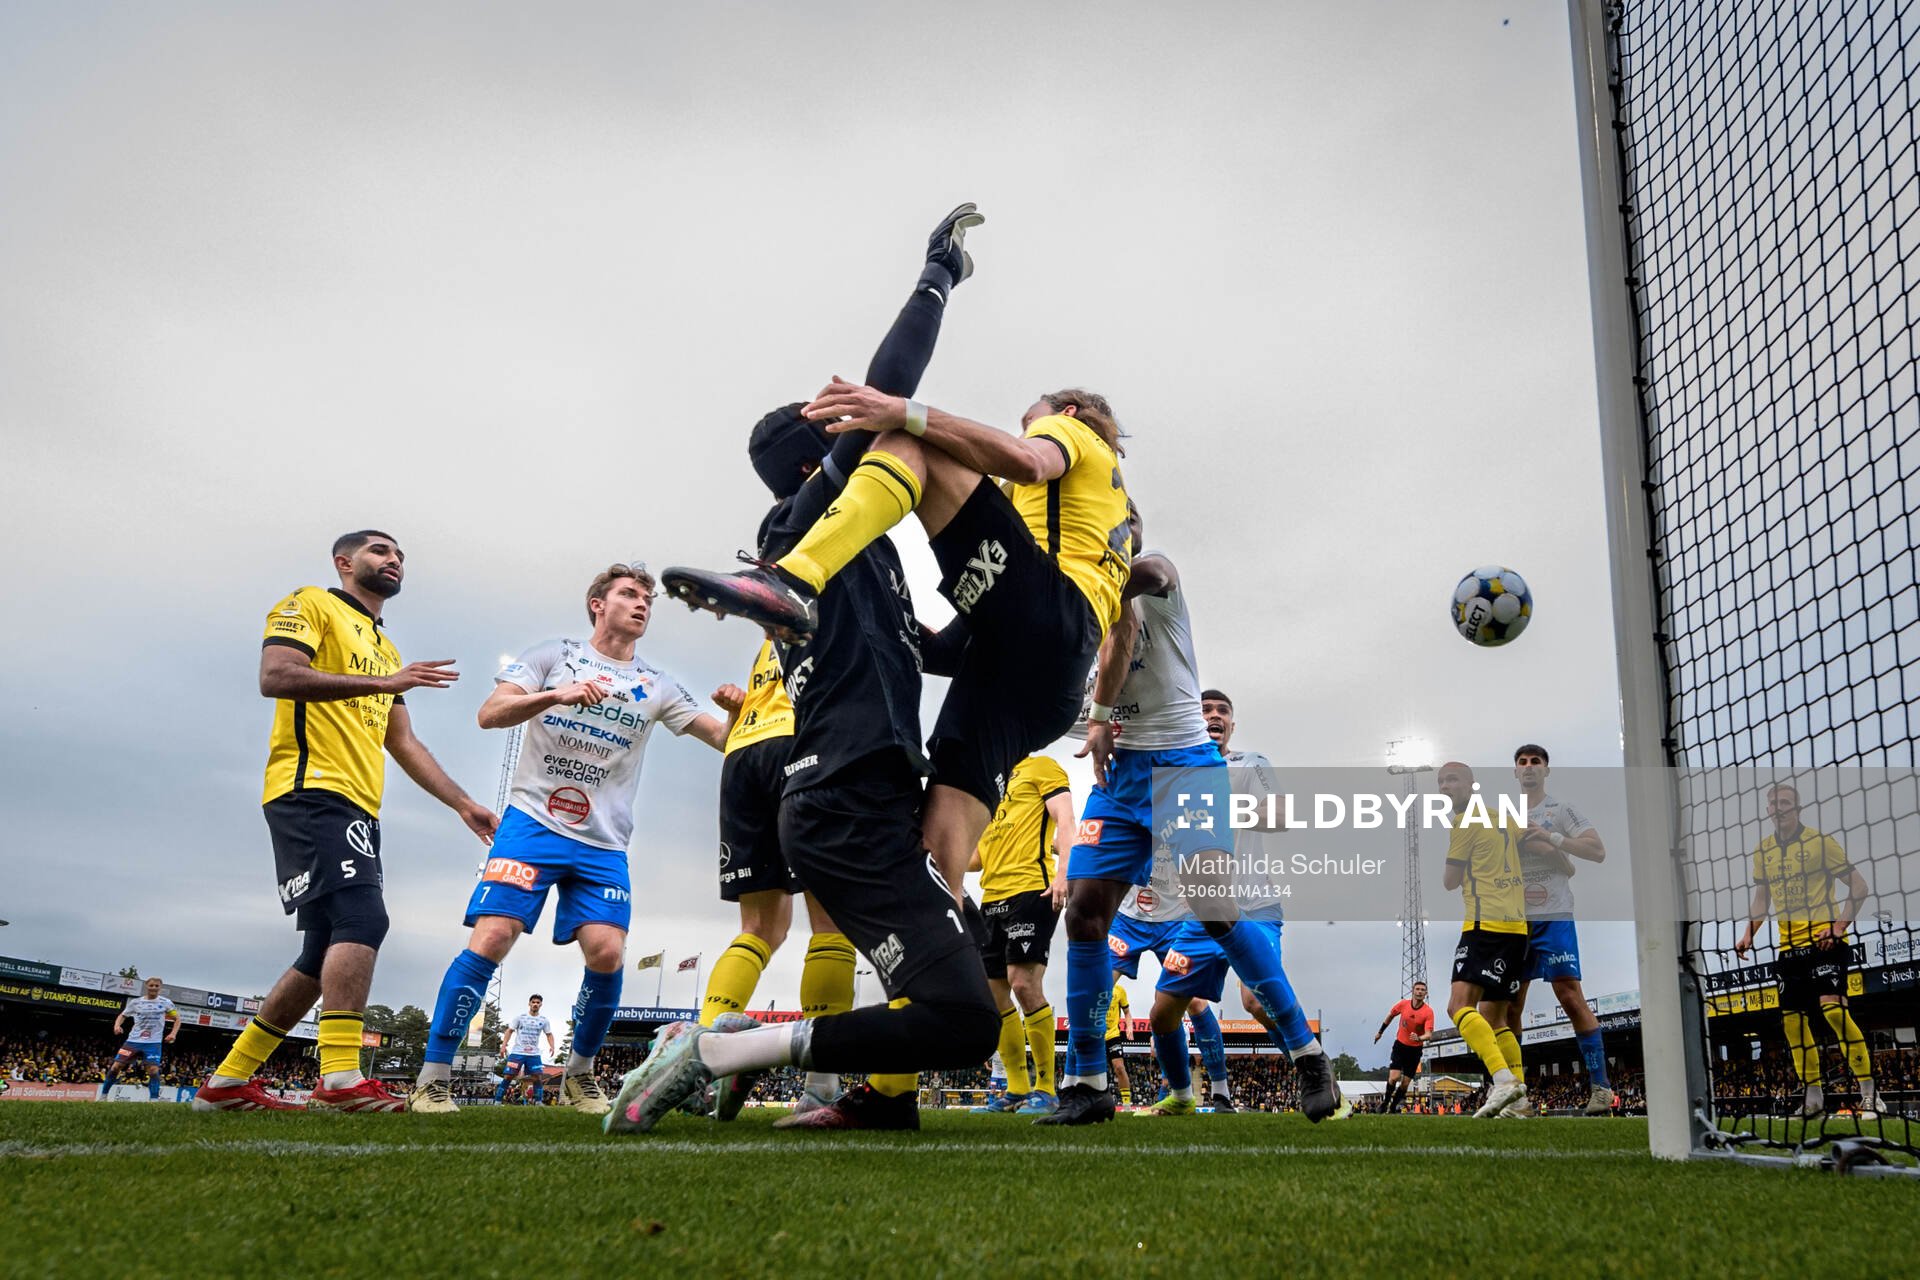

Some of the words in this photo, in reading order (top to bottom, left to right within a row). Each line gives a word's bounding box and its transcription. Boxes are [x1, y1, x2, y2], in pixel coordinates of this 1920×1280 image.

[271, 620, 306, 631] UNIBET
[543, 714, 633, 750] ZINKTEKNIK
[558, 734, 613, 758] NOMINIT
[546, 765, 601, 788] sweden
[550, 798, 589, 814] SANDAHLS
[340, 859, 357, 879] 5
[737, 867, 752, 878] Bil
[502, 874, 533, 890] GROUP
[479, 885, 492, 904] 7
[946, 908, 964, 934] 1
[43, 991, 76, 1004] UTANFÖR
[77, 994, 122, 1009] REKTANGELN
[207, 993, 222, 1009] dp
[707, 996, 740, 1010] 1939
